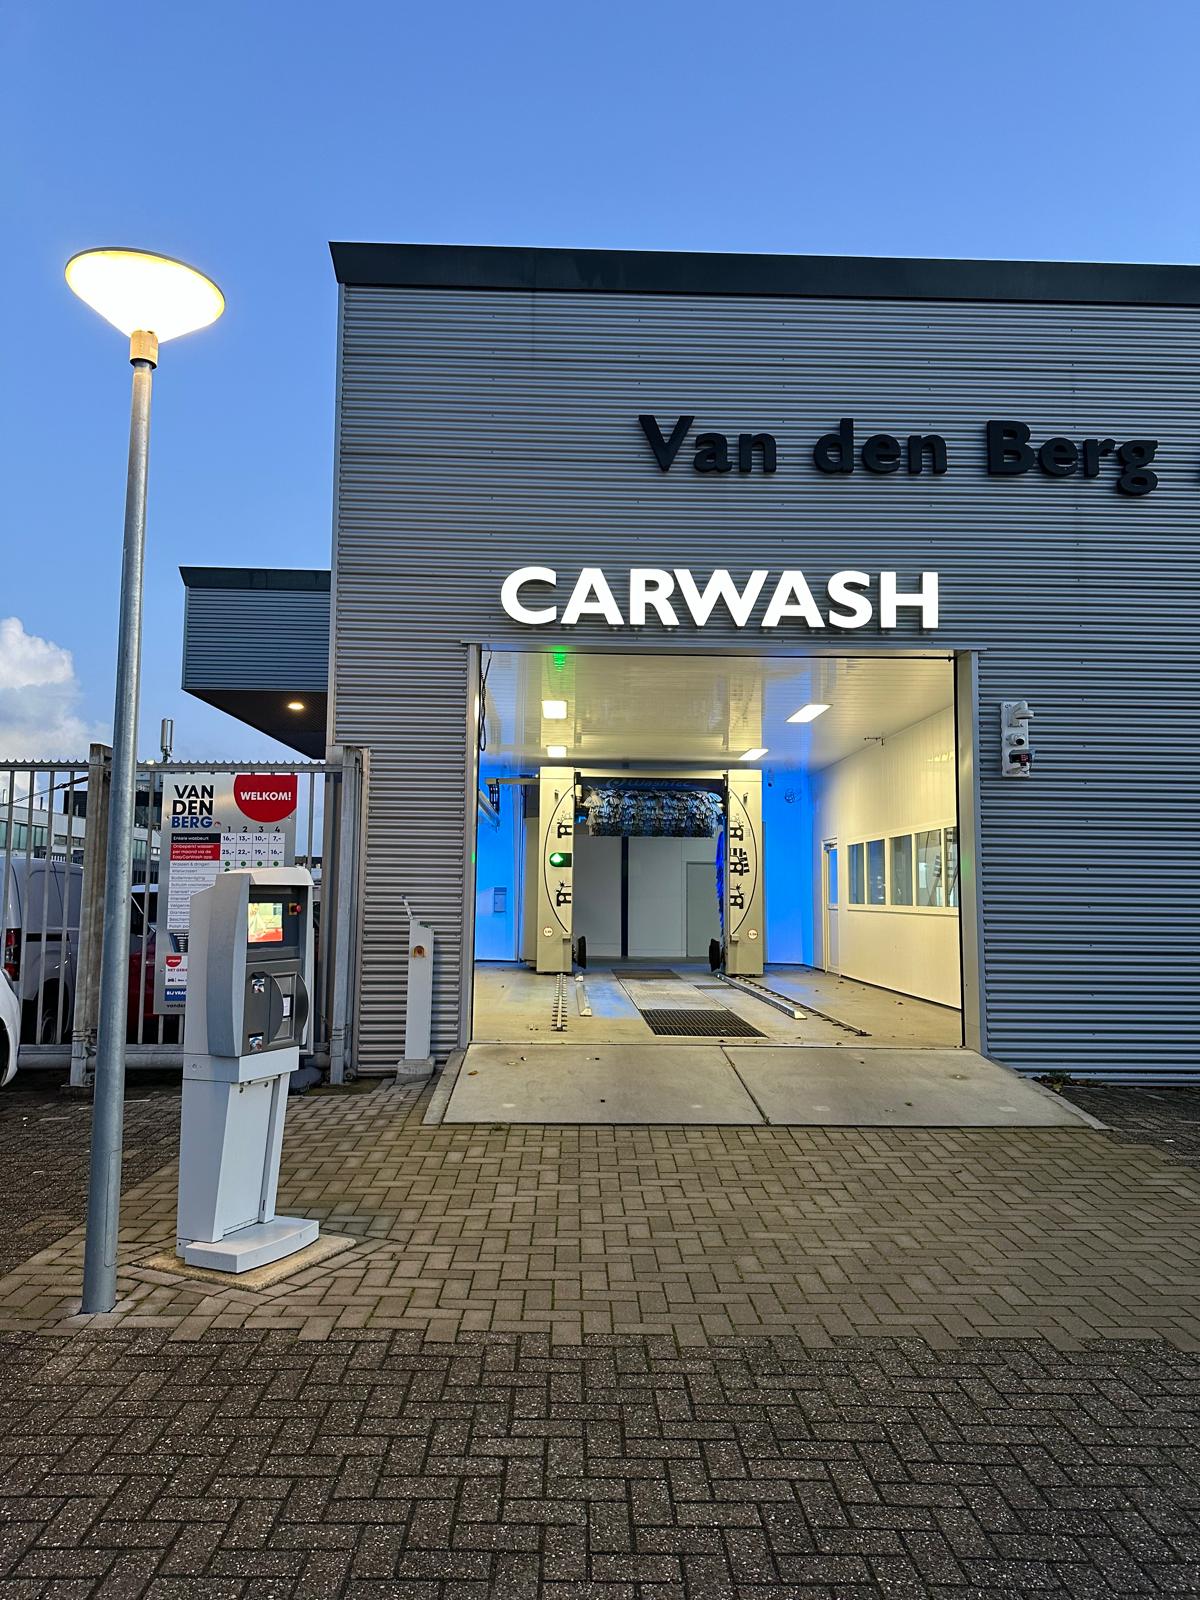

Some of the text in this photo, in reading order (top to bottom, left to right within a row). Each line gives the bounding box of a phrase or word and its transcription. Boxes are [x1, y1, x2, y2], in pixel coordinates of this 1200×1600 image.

[638, 415, 1160, 497] Van den Berg
[500, 566, 940, 630] CARWASH
[174, 785, 214, 799] VAN
[240, 791, 292, 801] WELKOM!
[172, 800, 213, 816] DEN
[171, 816, 213, 829] BERG
[223, 835, 235, 843] 16,-
[239, 835, 251, 843] 13,-
[255, 835, 267, 843] 10,-
[273, 835, 282, 843] 7,-
